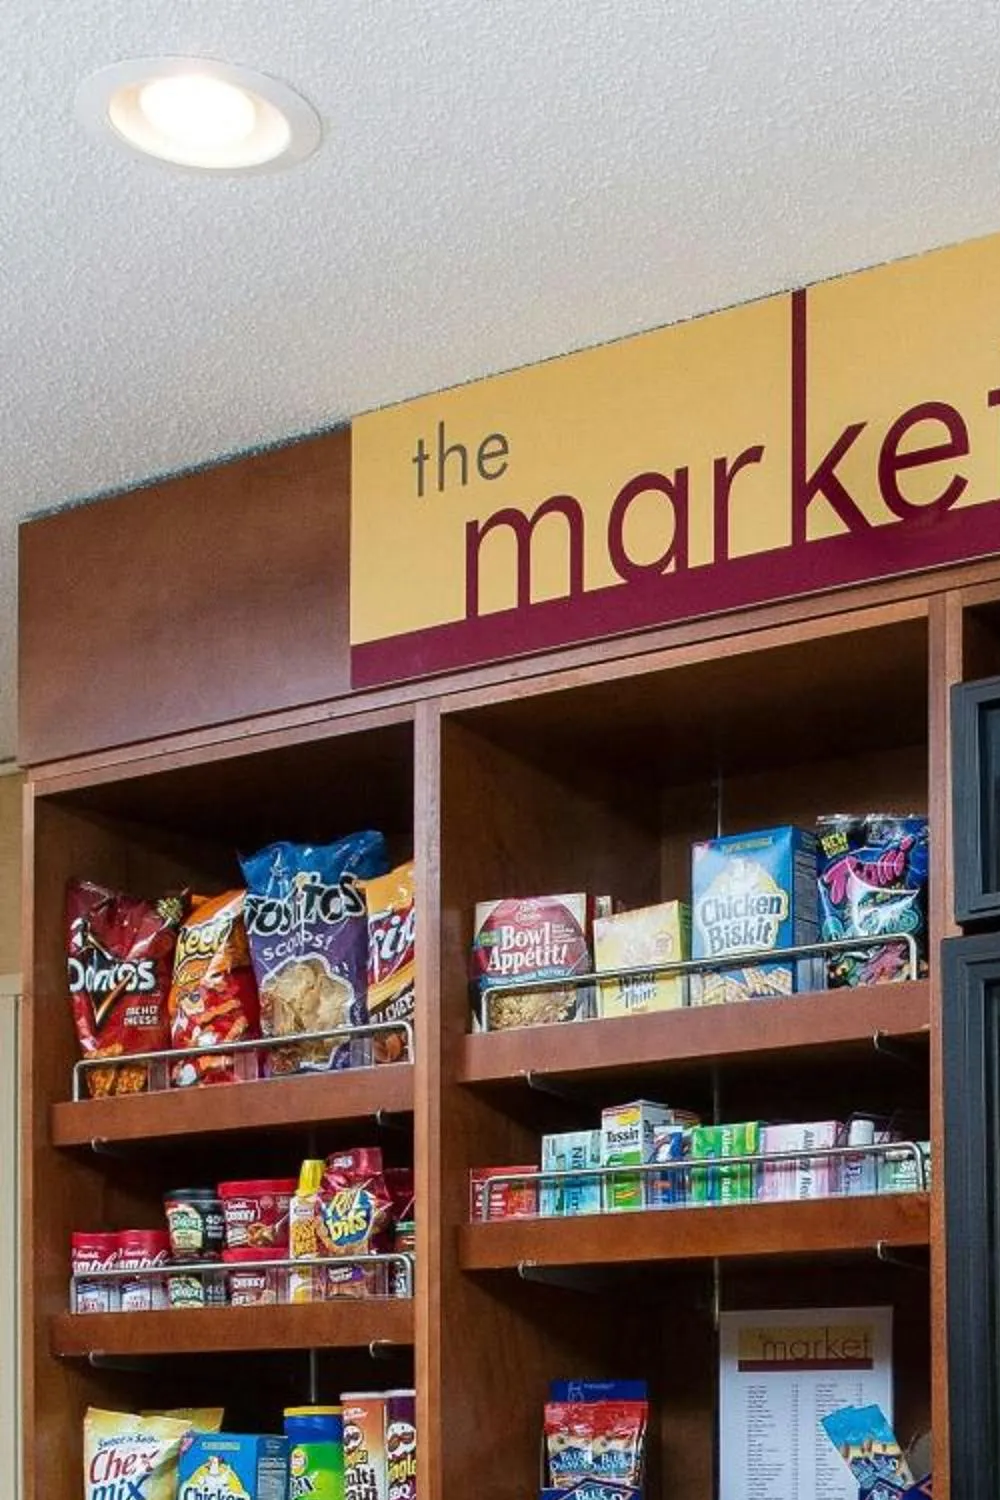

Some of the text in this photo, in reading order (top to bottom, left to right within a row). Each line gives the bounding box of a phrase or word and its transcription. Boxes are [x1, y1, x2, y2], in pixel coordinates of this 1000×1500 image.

[412, 421, 510, 498] the
[702, 896, 782, 927] Chicken
[501, 923, 549, 951] Bowl
[709, 922, 772, 951] Biskit
[67, 957, 156, 993] Doritos
[90, 1449, 160, 1485] Chex
